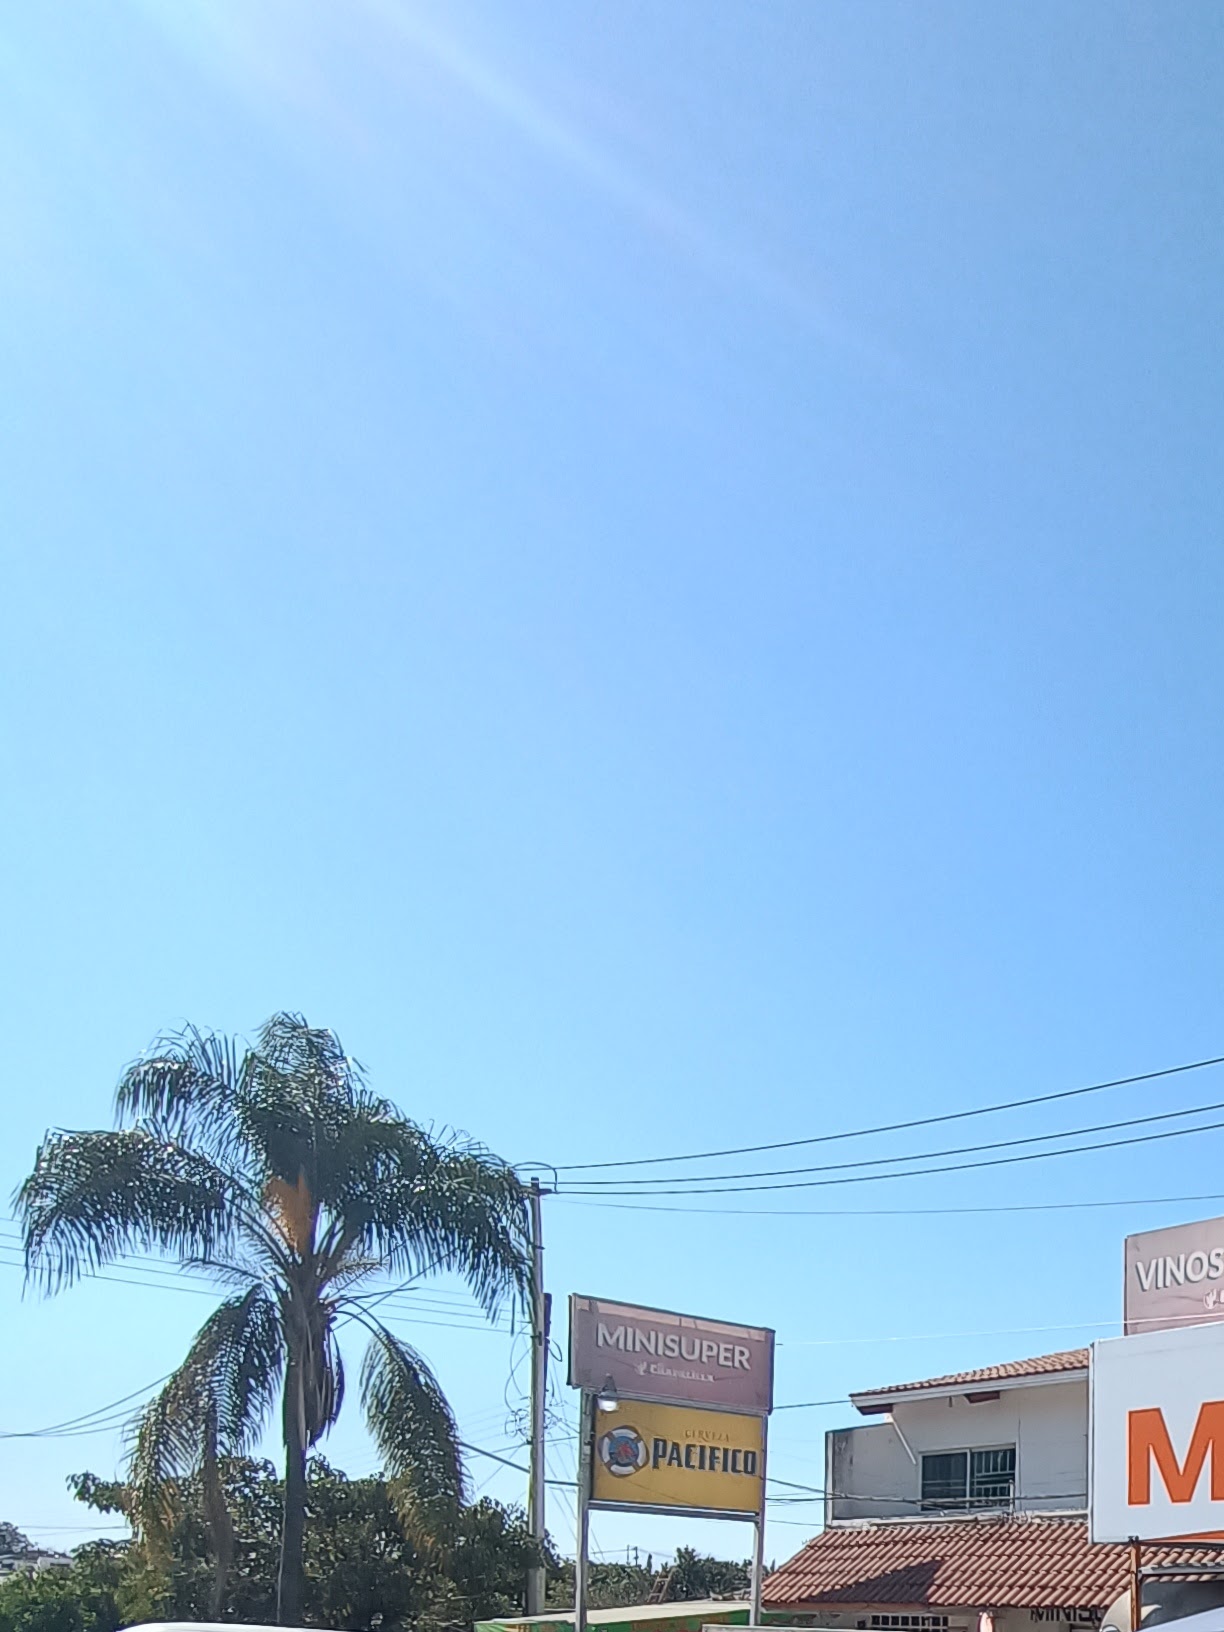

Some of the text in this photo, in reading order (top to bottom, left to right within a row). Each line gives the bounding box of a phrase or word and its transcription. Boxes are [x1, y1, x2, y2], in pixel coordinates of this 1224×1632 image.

[1136, 1247, 1224, 1292] VINOS
[597, 1323, 751, 1370] MINISUPER
[652, 1437, 757, 1475] PACIFICO
